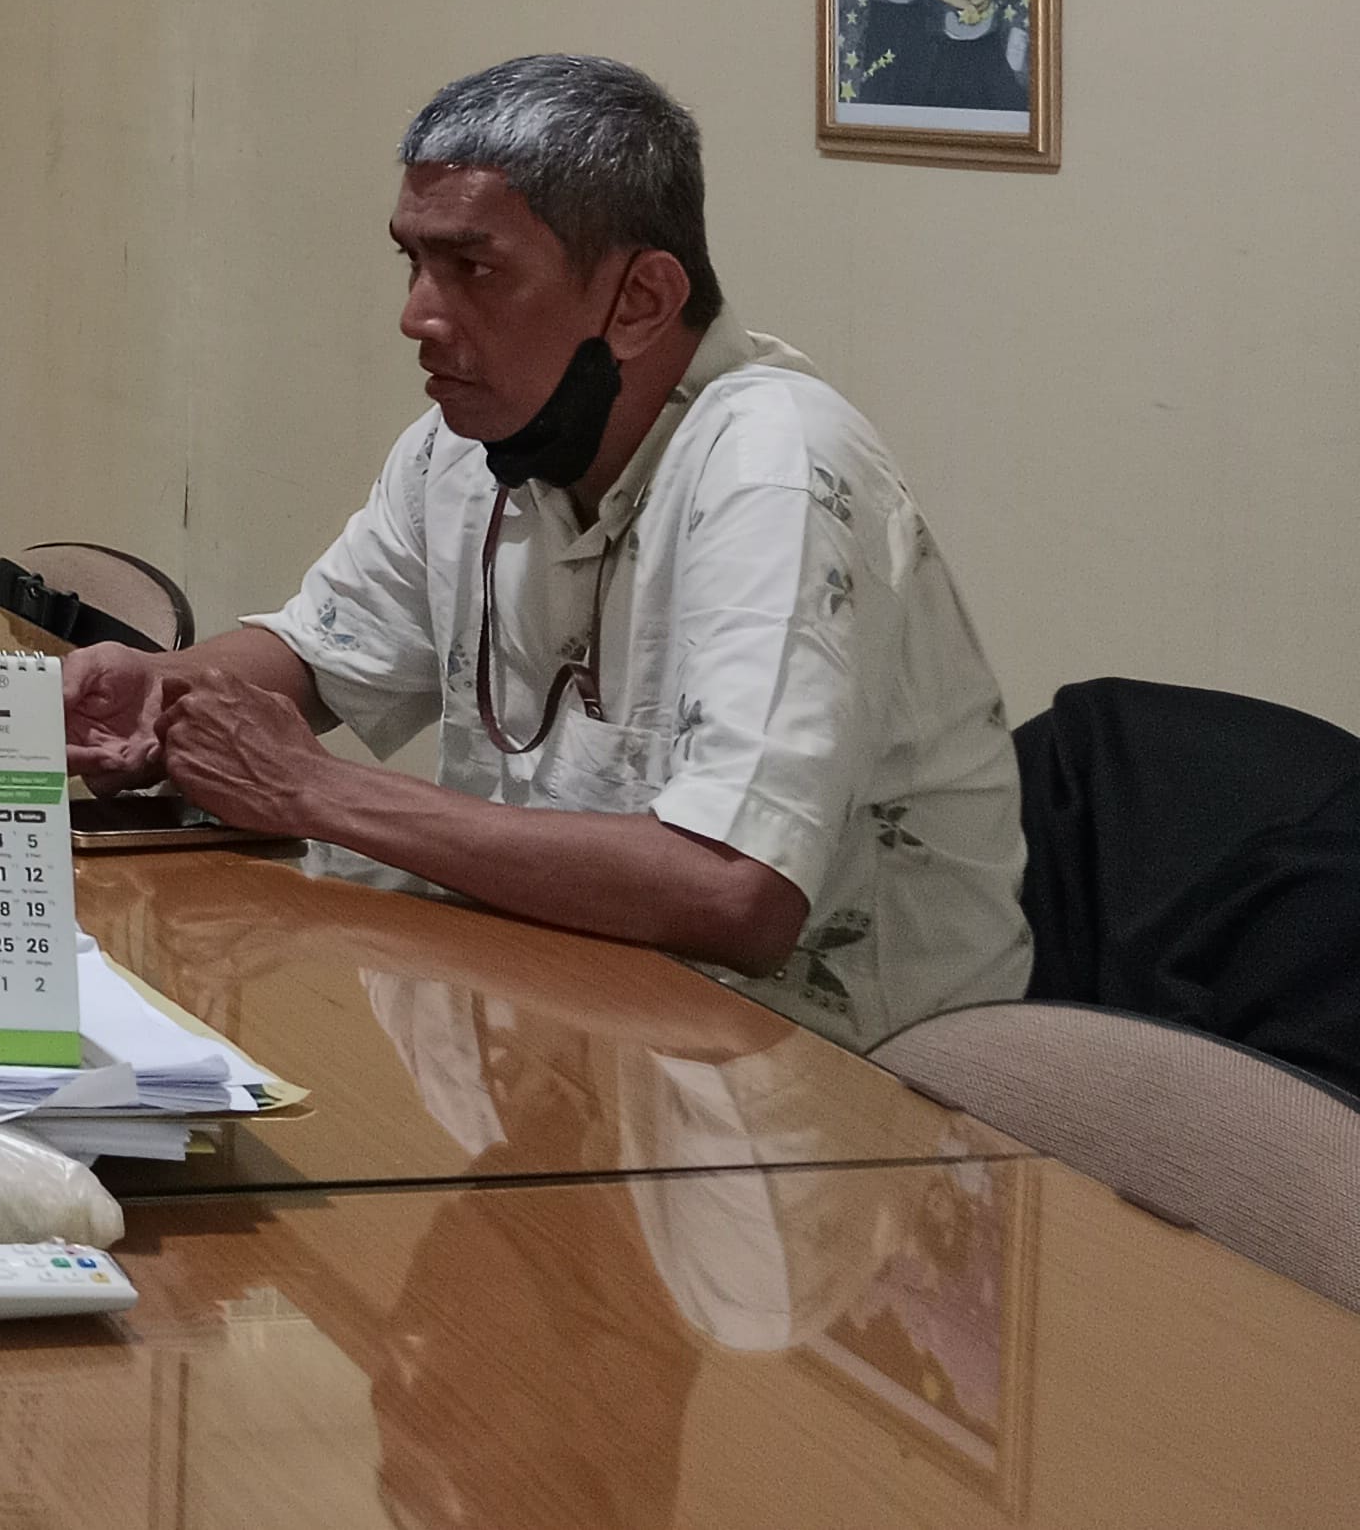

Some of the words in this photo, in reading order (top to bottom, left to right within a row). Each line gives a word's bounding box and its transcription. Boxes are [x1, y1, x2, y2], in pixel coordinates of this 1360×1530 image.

[28, 834, 38, 848] 5
[26, 867, 43, 882] 12
[27, 902, 45, 917] 19
[27, 938, 49, 953] 26
[2, 977, 8, 991] 1
[36, 978, 45, 992] 2
